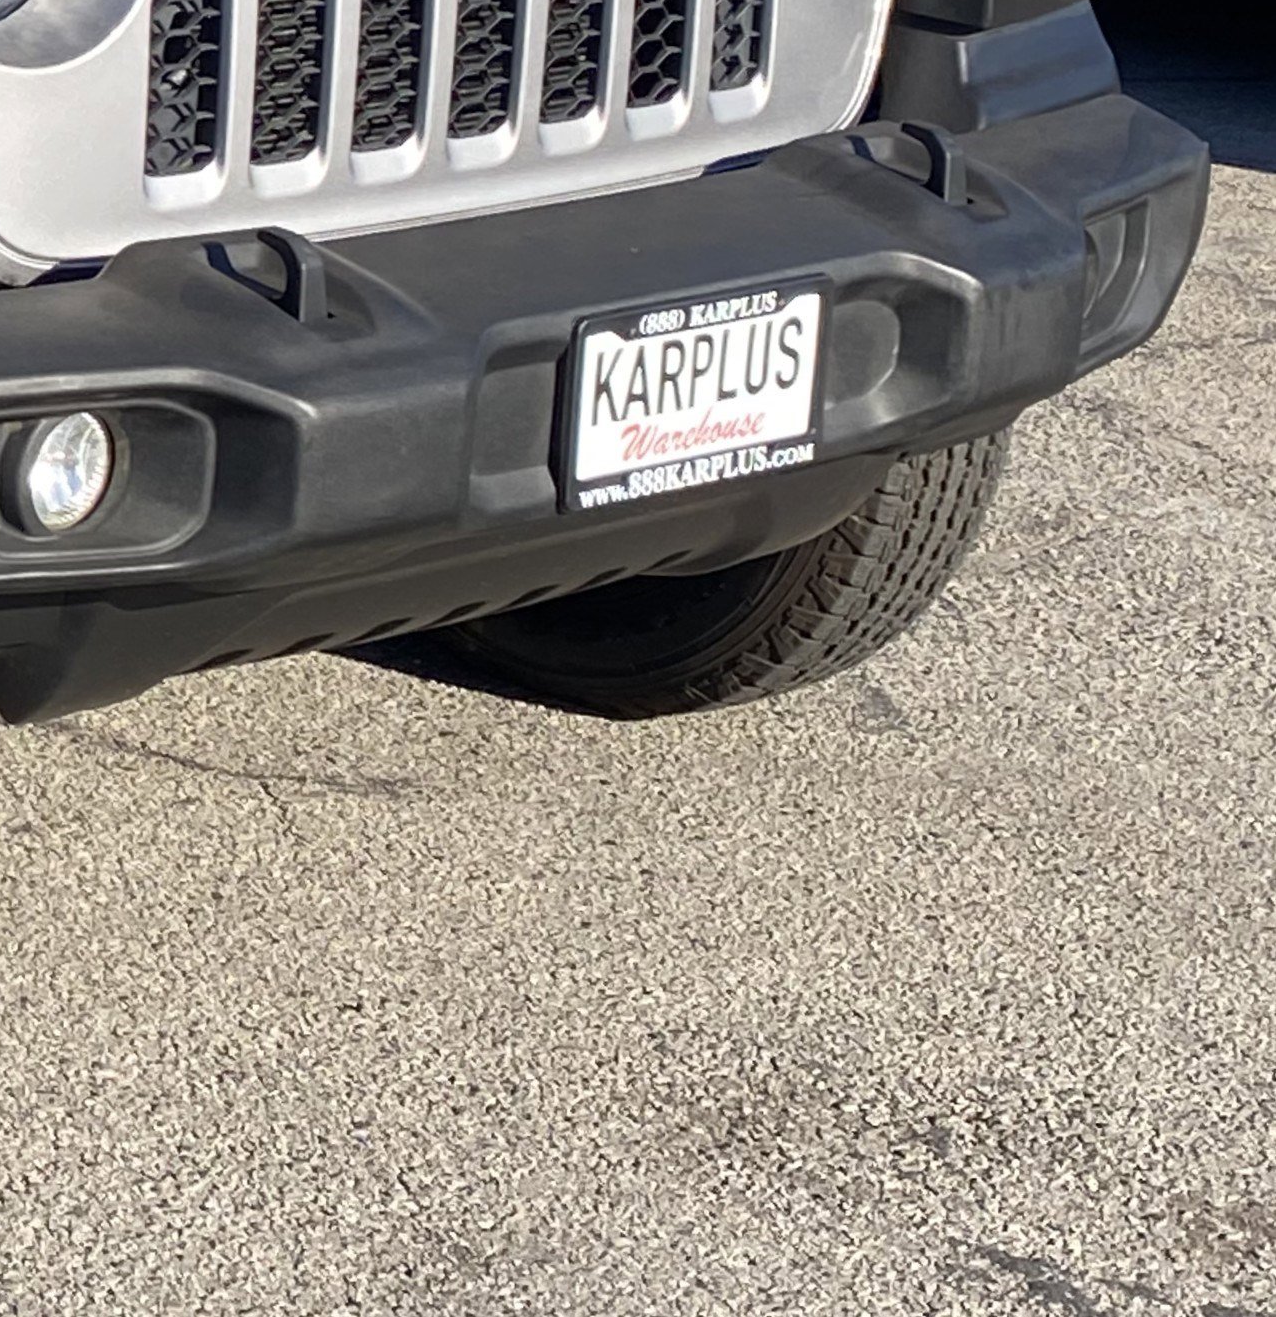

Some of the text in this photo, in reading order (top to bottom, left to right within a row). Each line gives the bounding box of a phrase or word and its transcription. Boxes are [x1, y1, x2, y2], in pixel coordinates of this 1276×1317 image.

[638, 290, 778, 336] (888) KARPLUS
[591, 315, 804, 427] KARPLUS
[620, 405, 767, 462] Warehouse
